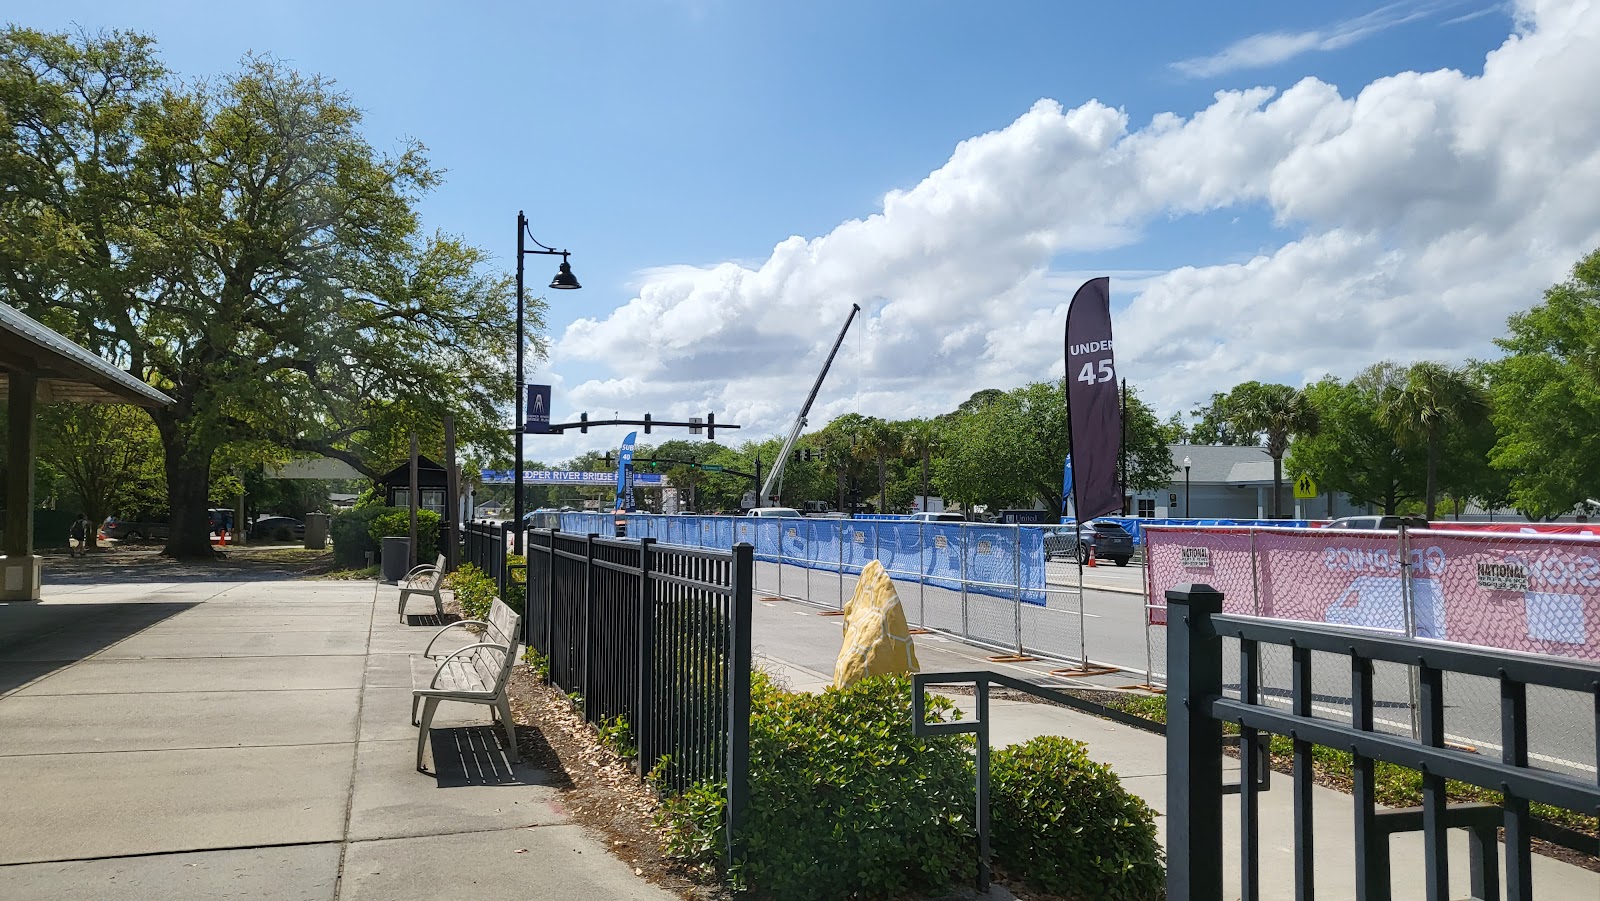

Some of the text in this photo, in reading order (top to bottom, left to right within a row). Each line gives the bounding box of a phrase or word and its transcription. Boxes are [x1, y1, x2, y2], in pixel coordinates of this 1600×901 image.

[1070, 340, 1113, 356] UNDER
[1077, 359, 1114, 386] 45
[622, 443, 634, 451] SUB
[553, 471, 581, 480] RIVER
[582, 472, 613, 481] BRIDGE
[1015, 514, 1037, 522] United
[1181, 548, 1208, 558] NATIONAL
[1477, 563, 1526, 579] NATIONAL
